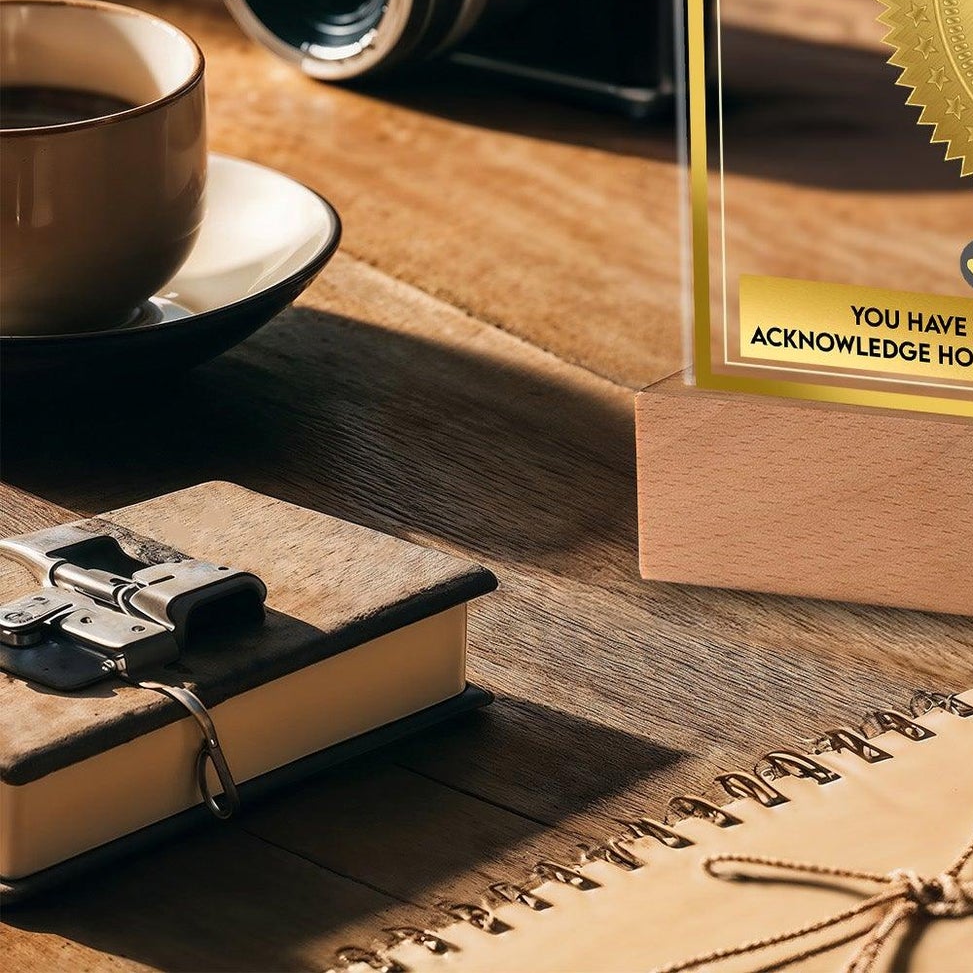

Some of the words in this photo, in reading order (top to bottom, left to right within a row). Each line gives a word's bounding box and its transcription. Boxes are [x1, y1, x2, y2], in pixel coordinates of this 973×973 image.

[850, 305, 900, 329] YOU
[907, 312, 967, 337] HAVE
[750, 326, 930, 364] ACKNOWLEDGE
